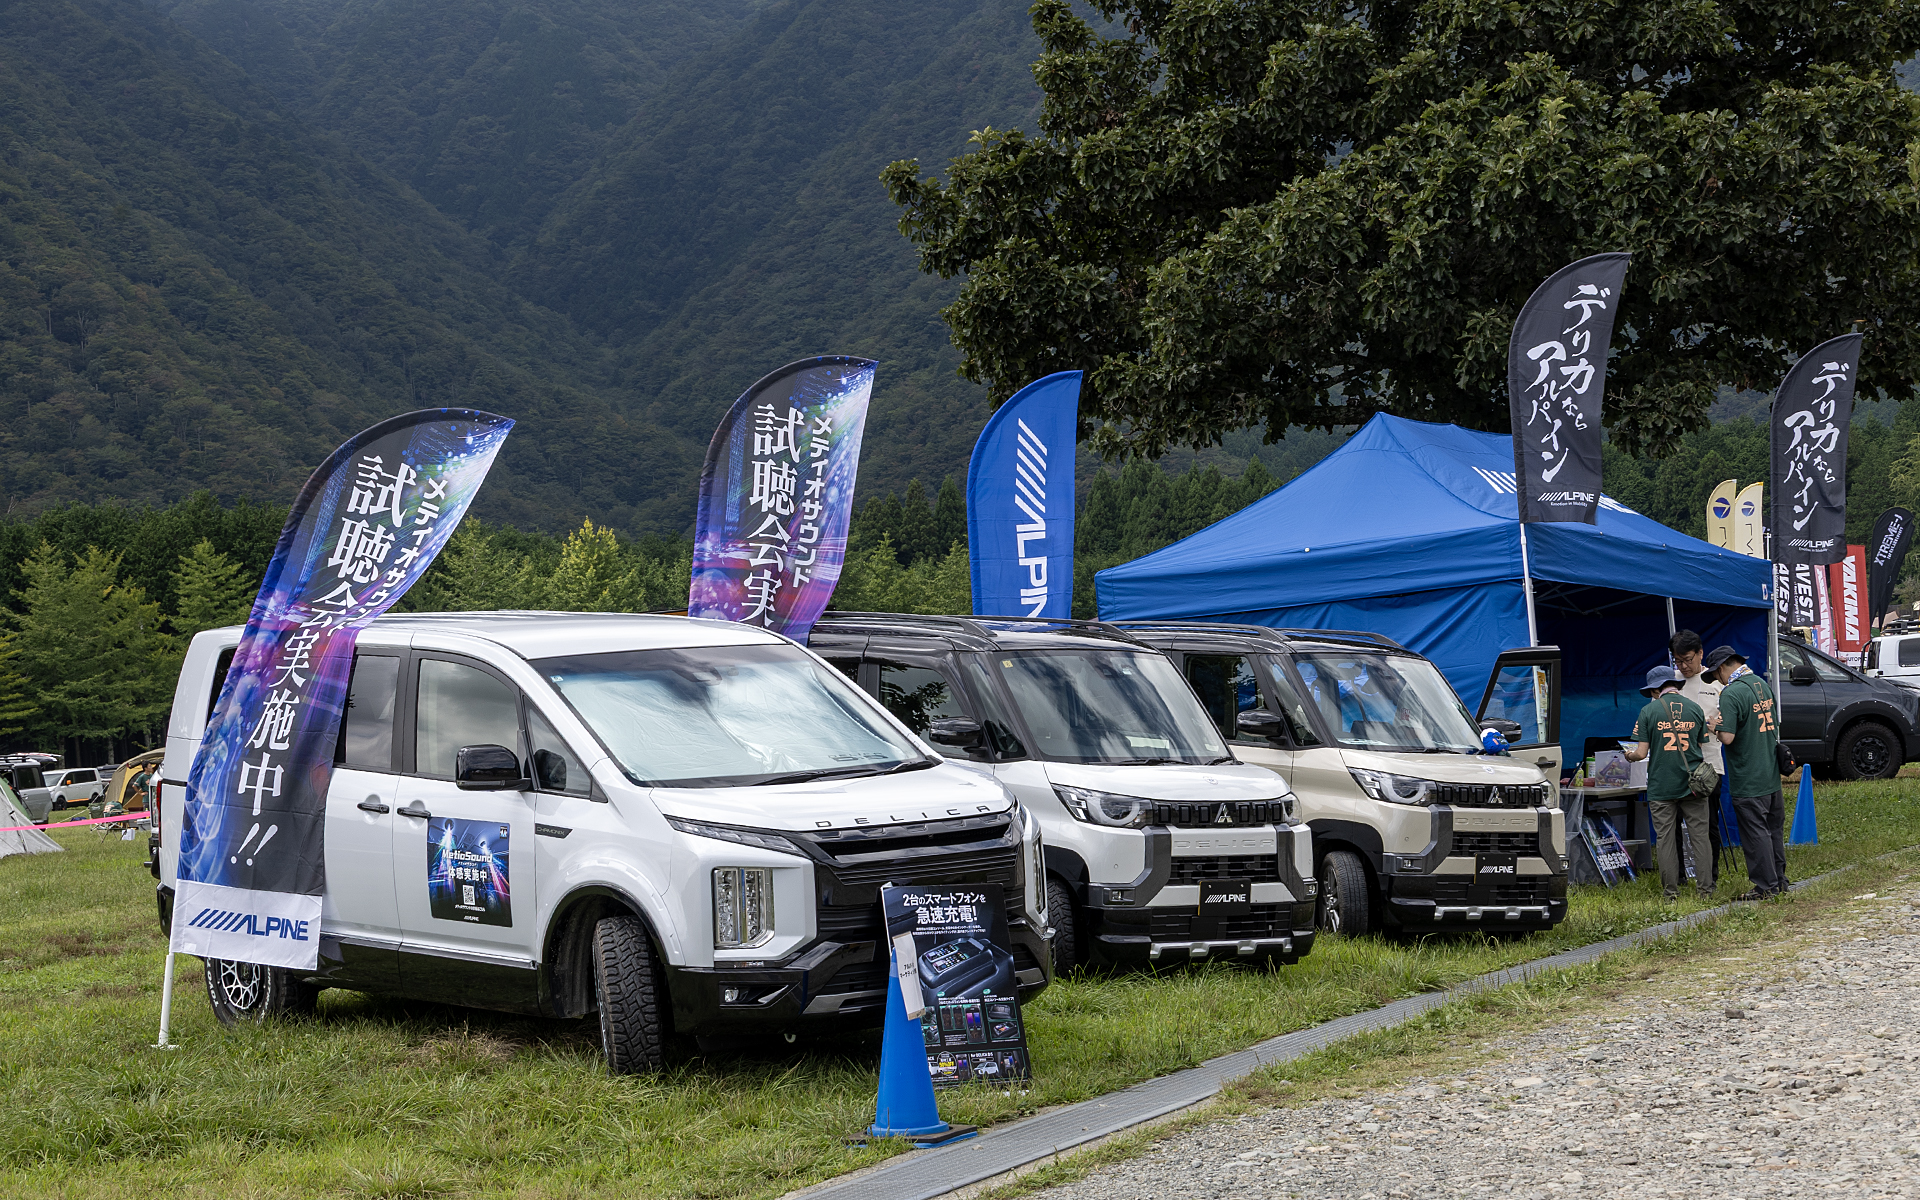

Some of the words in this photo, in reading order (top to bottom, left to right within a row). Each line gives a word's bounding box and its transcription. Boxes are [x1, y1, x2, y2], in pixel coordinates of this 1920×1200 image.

[1558, 284, 1611, 431] デリカなら
[1524, 341, 1569, 483] アルパイン
[1810, 361, 1850, 484] デリカなら
[1783, 410, 1819, 531] アルパイン
[793, 416, 832, 588] メティオサウンド
[1557, 491, 1595, 503] ALPINE
[1842, 555, 1861, 641] YAKIMA
[1757, 711, 1776, 733] 25
[1662, 732, 1690, 752] 25
[815, 805, 991, 828] DELICA
[1454, 816, 1537, 828] DELICA
[1173, 837, 1275, 850] DELICA
[442, 849, 493, 863] MetioSound
[902, 891, 987, 907] 2台のスマートフォンを
[915, 904, 978, 926] 急速充電!
